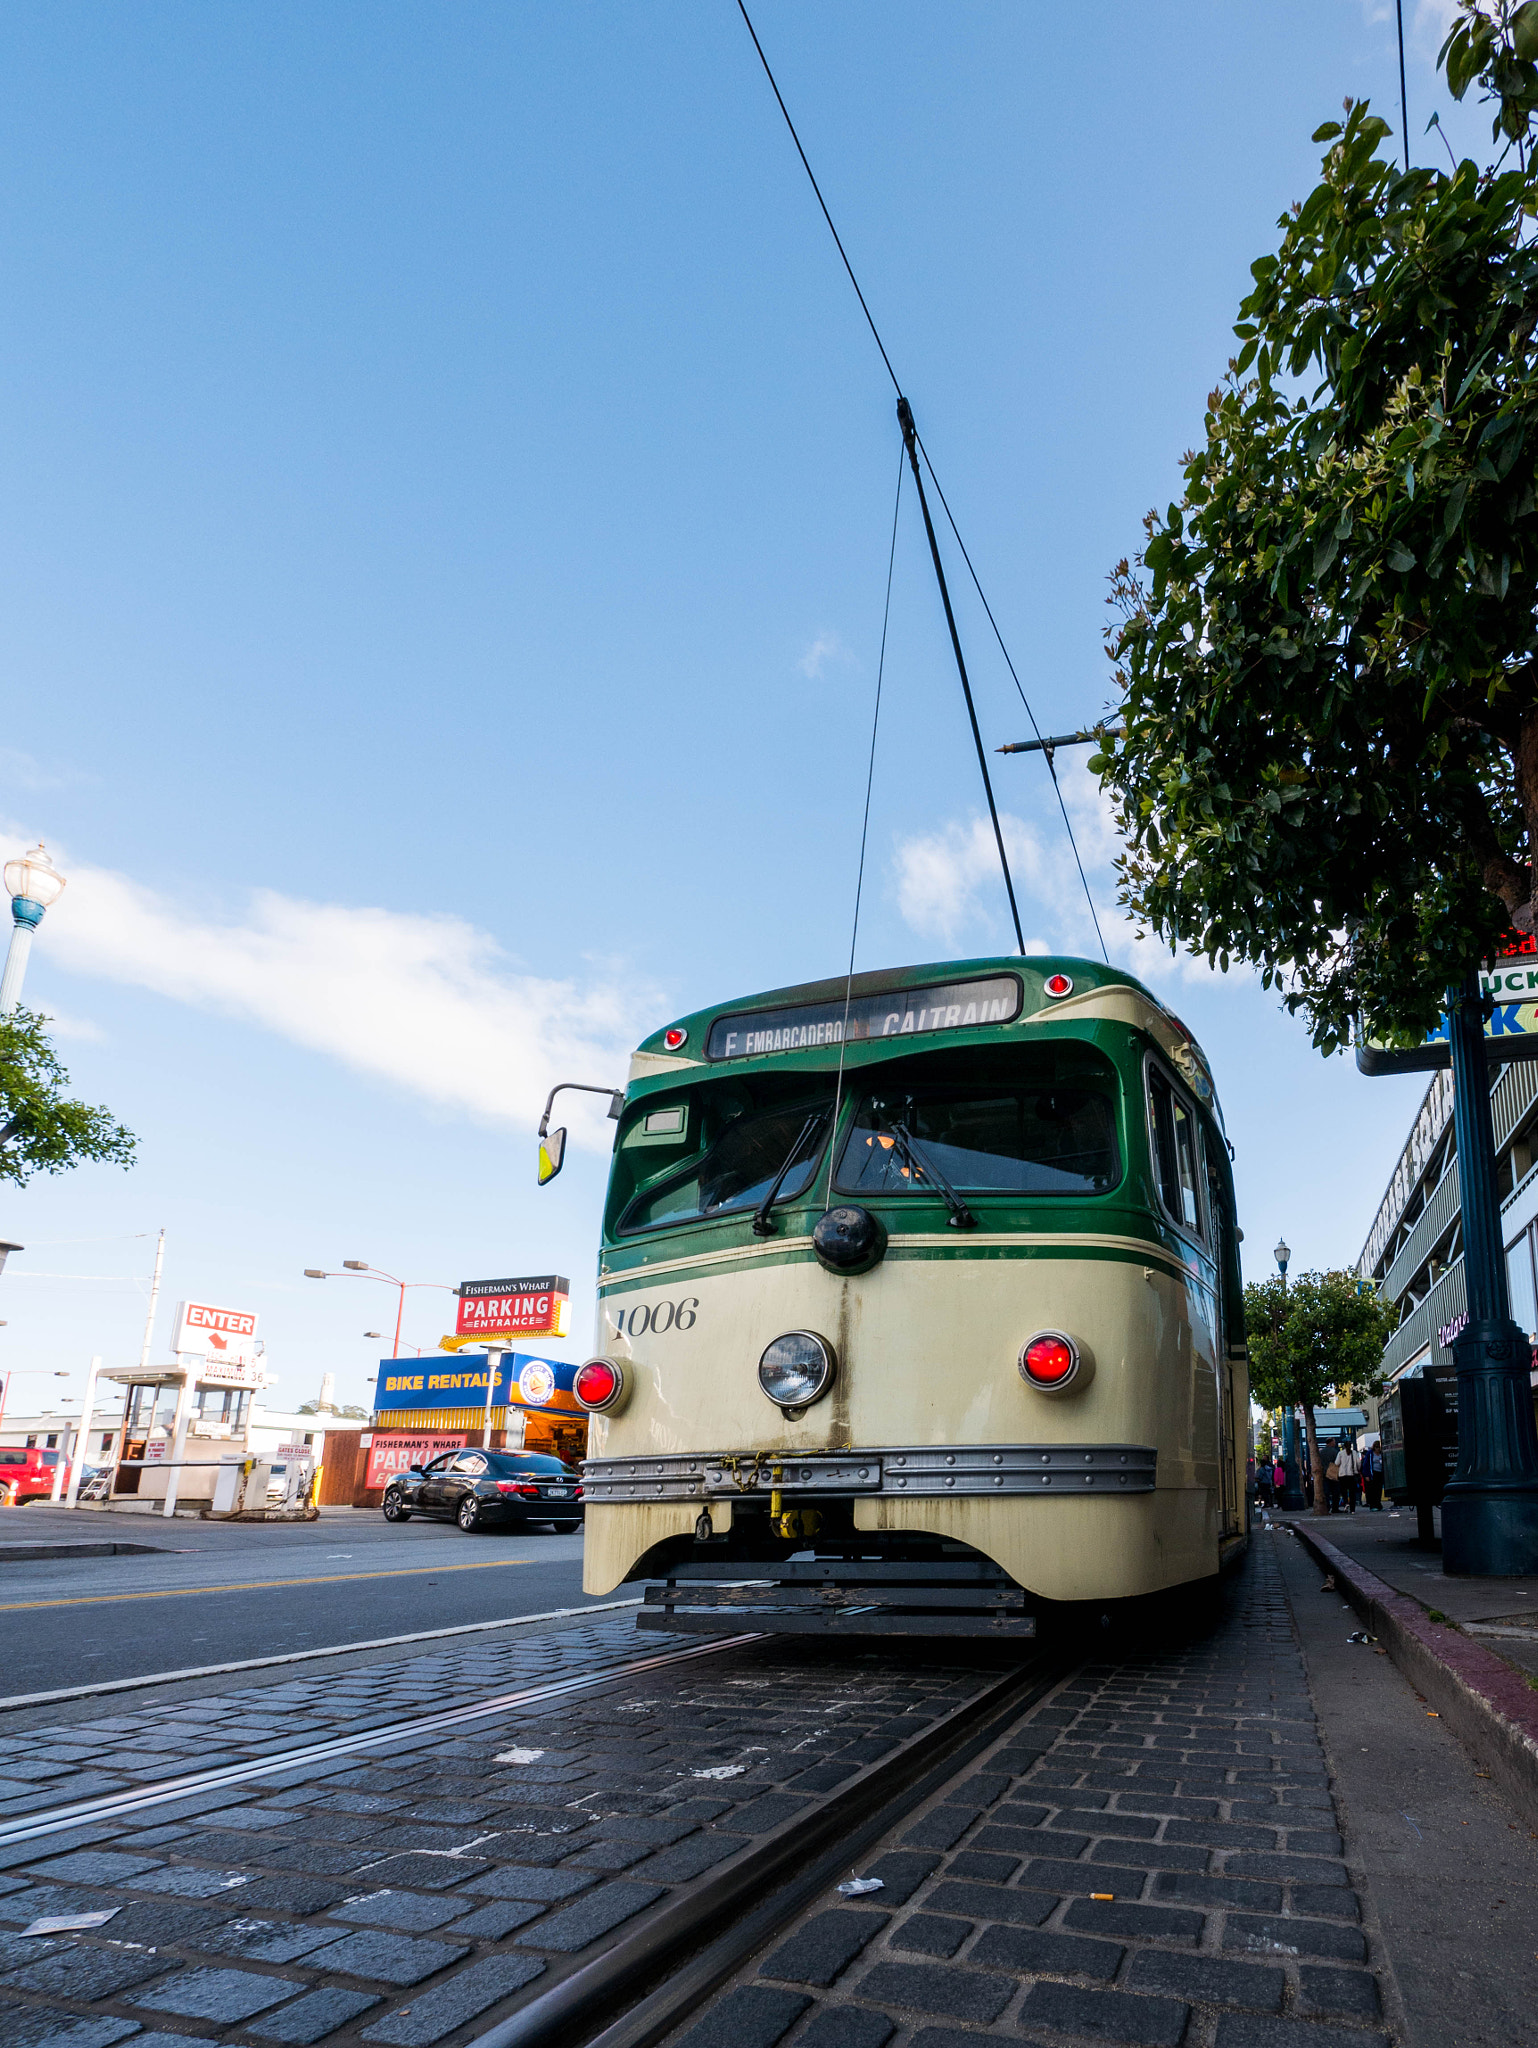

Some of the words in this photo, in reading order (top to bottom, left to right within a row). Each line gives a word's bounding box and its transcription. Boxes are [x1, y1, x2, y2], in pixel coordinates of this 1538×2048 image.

[465, 1284, 517, 1295] FISHERMAN'S
[519, 1282, 550, 1291] WHARF
[463, 1296, 549, 1318] PARKING
[189, 1308, 253, 1333] ENTER
[473, 1317, 535, 1328] ENTRANCE
[612, 1298, 700, 1342] 1006
[386, 1376, 424, 1391] BIKE
[428, 1372, 503, 1389] RENTALS
[375, 1441, 429, 1449] FISHERMAN'S
[433, 1441, 462, 1449] WHARF
